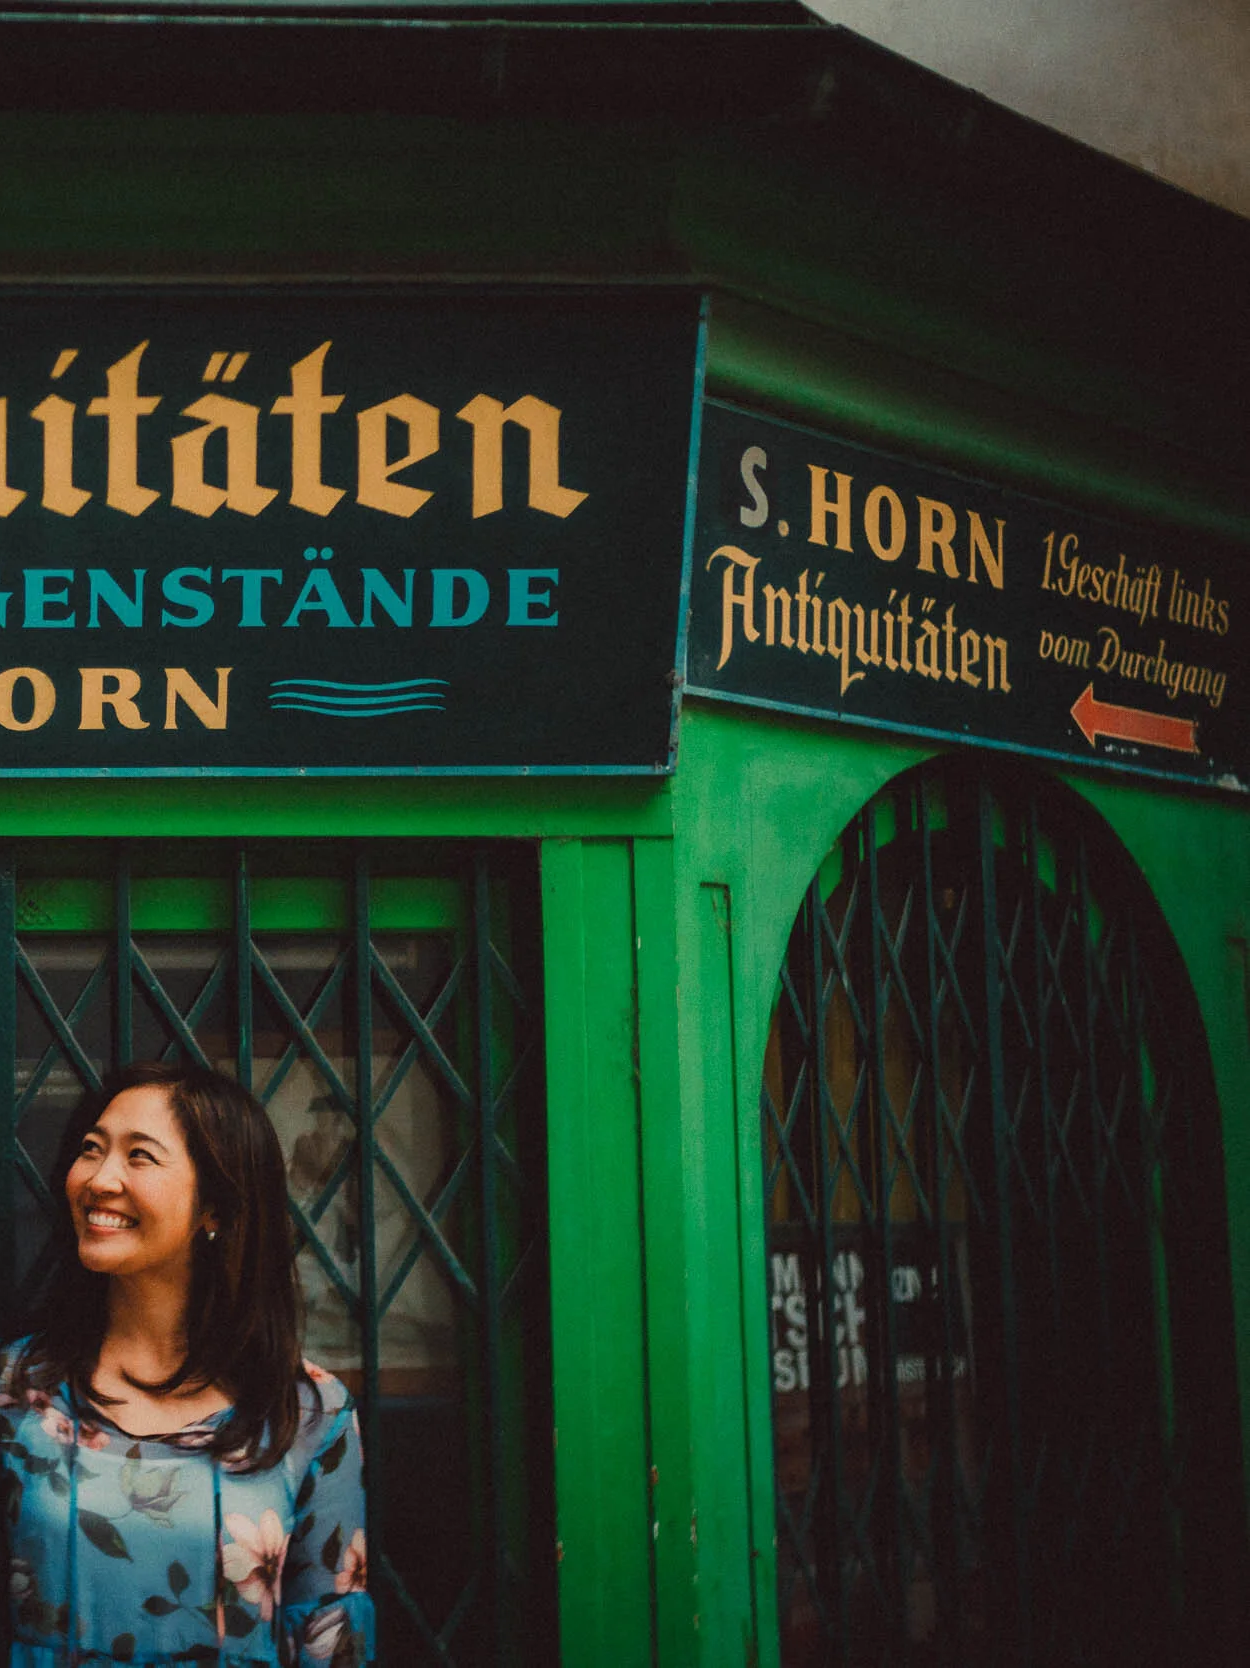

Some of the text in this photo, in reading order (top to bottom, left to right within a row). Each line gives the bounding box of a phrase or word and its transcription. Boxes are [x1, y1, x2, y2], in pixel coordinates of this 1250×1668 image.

[739, 445, 1007, 591] S. HORN
[705, 544, 1012, 697] Antiquitäten
[1168, 568, 1230, 636] links
[1038, 626, 1227, 709] vom Durchgang
